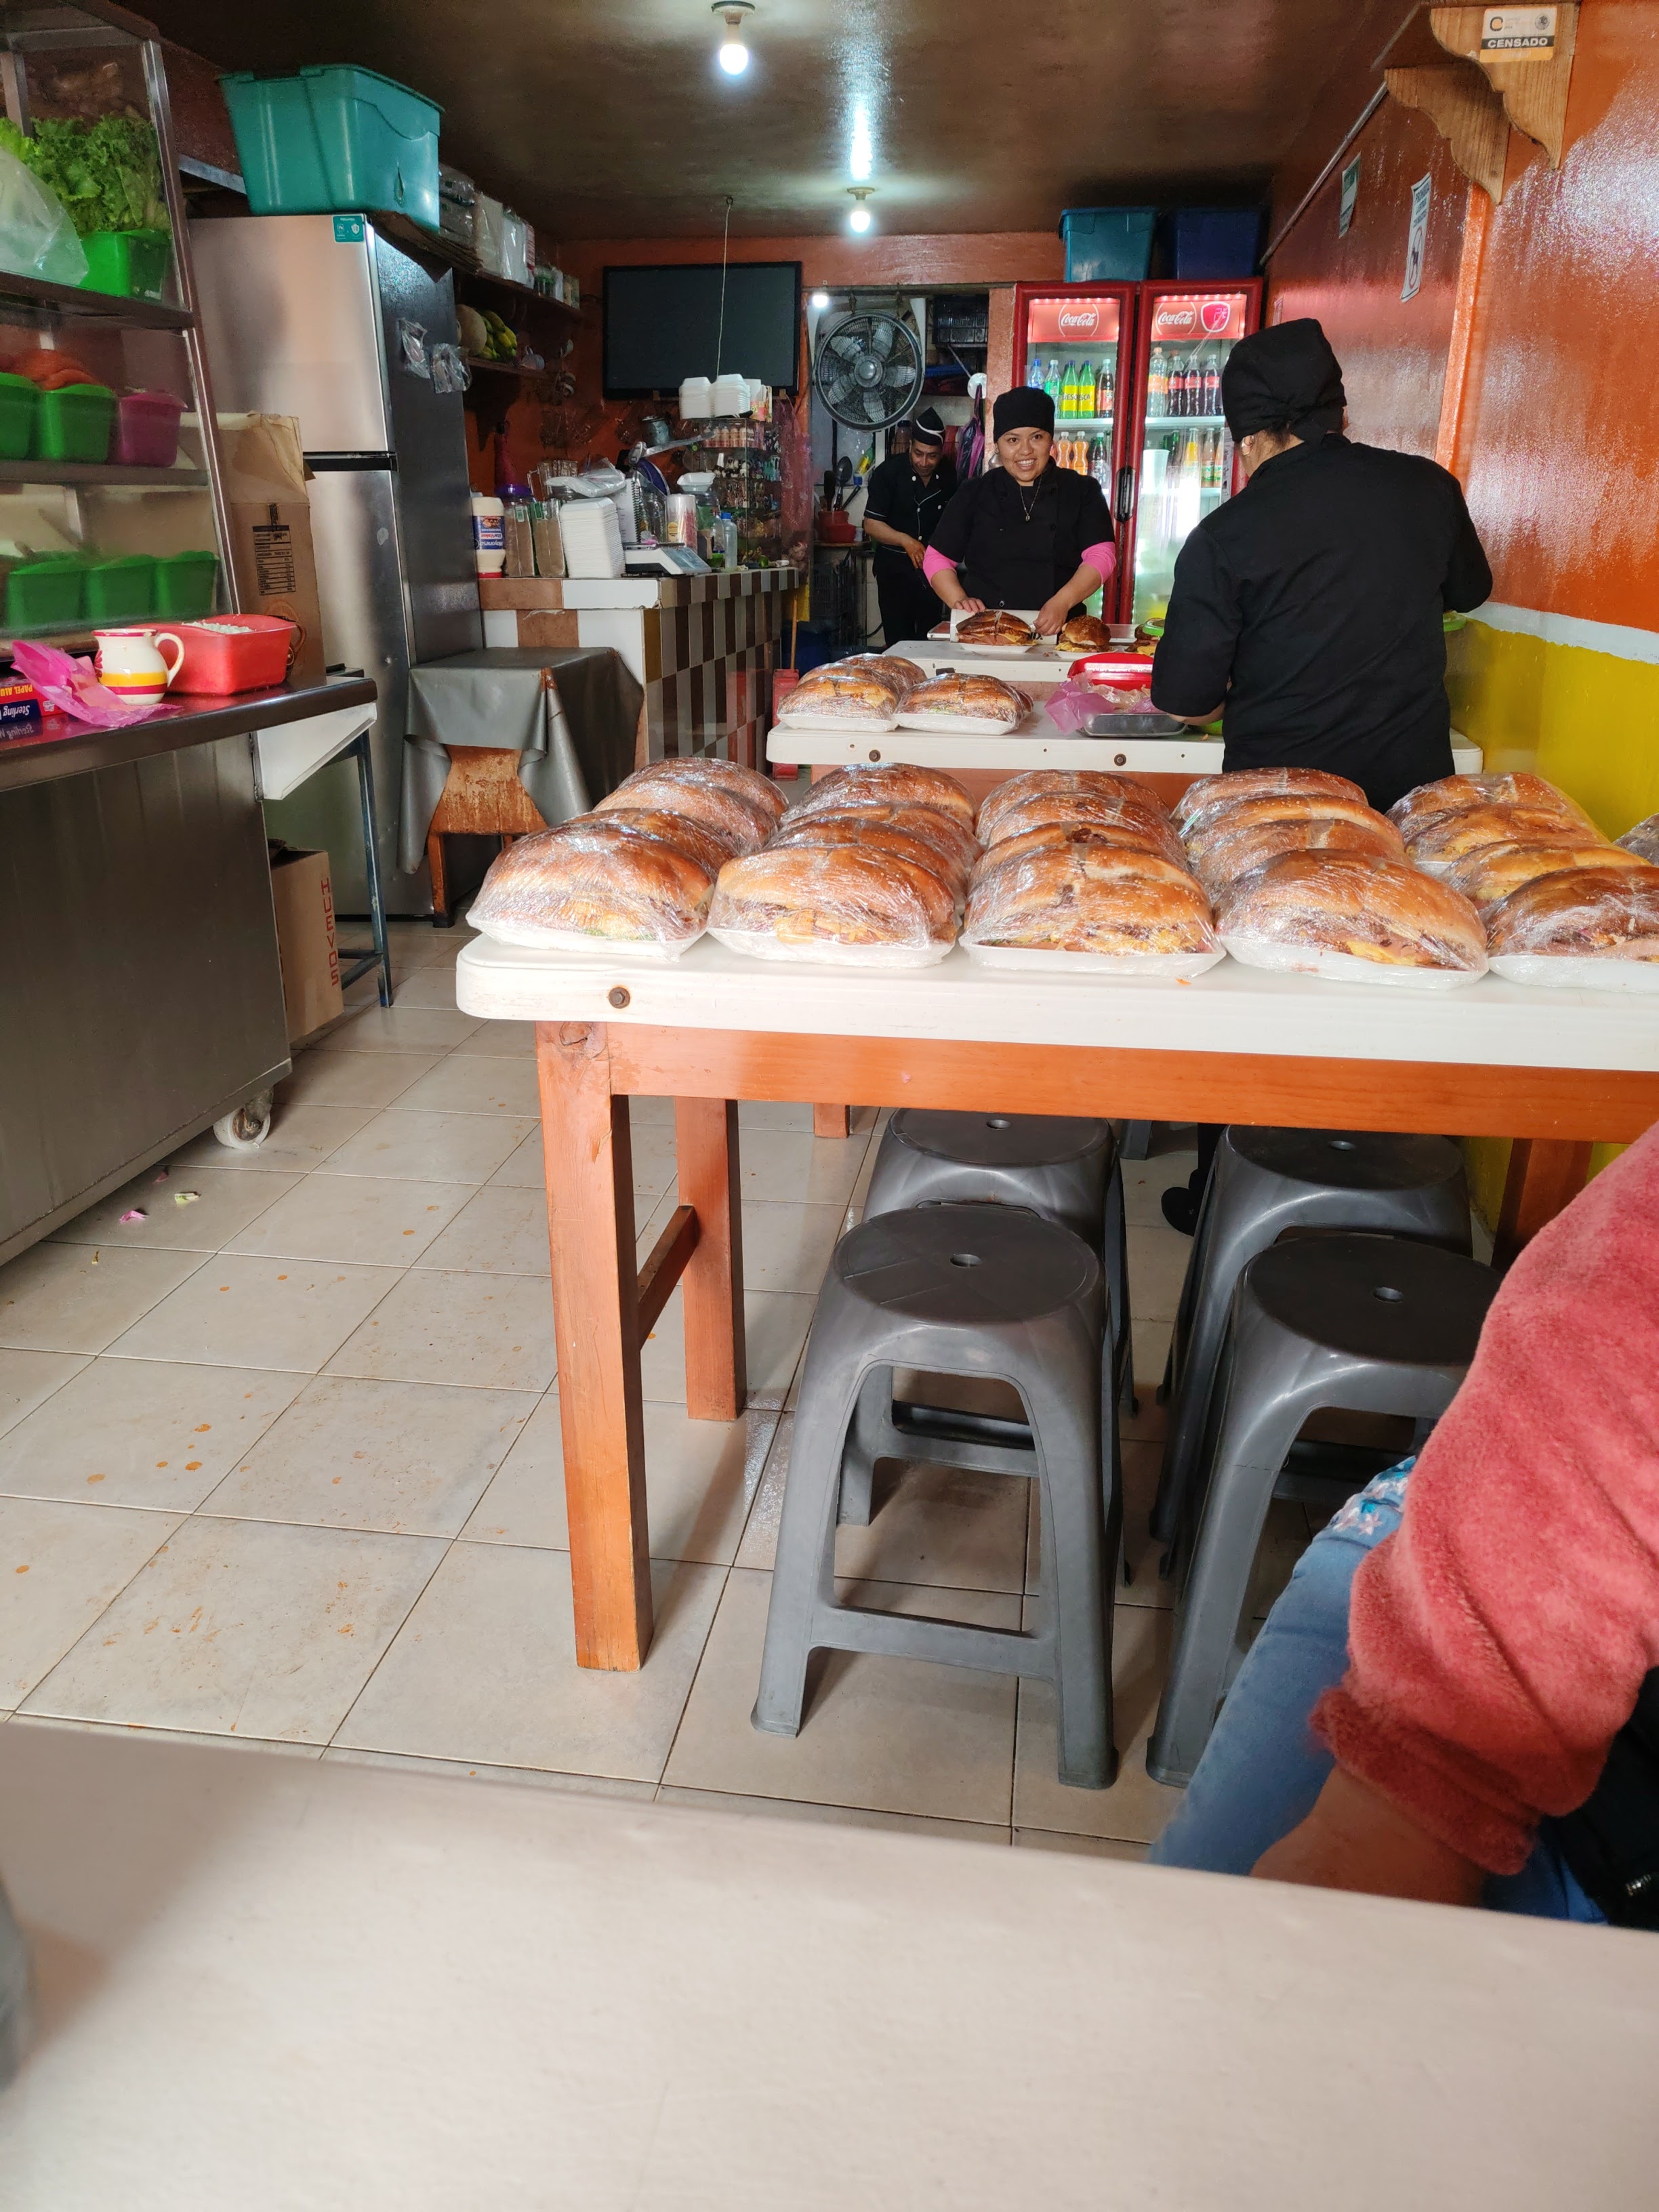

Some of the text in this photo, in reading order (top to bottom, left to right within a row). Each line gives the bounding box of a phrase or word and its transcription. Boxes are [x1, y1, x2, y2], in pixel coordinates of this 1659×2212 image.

[1488, 37, 1549, 48] CENSADO
[1060, 312, 1097, 327] Coca-Cola
[1158, 310, 1194, 325] Coca-Cola
[0, 684, 33, 697] PAPEL ALU
[3, 705, 30, 718] Sterling
[321, 877, 340, 987] HUEVOS
